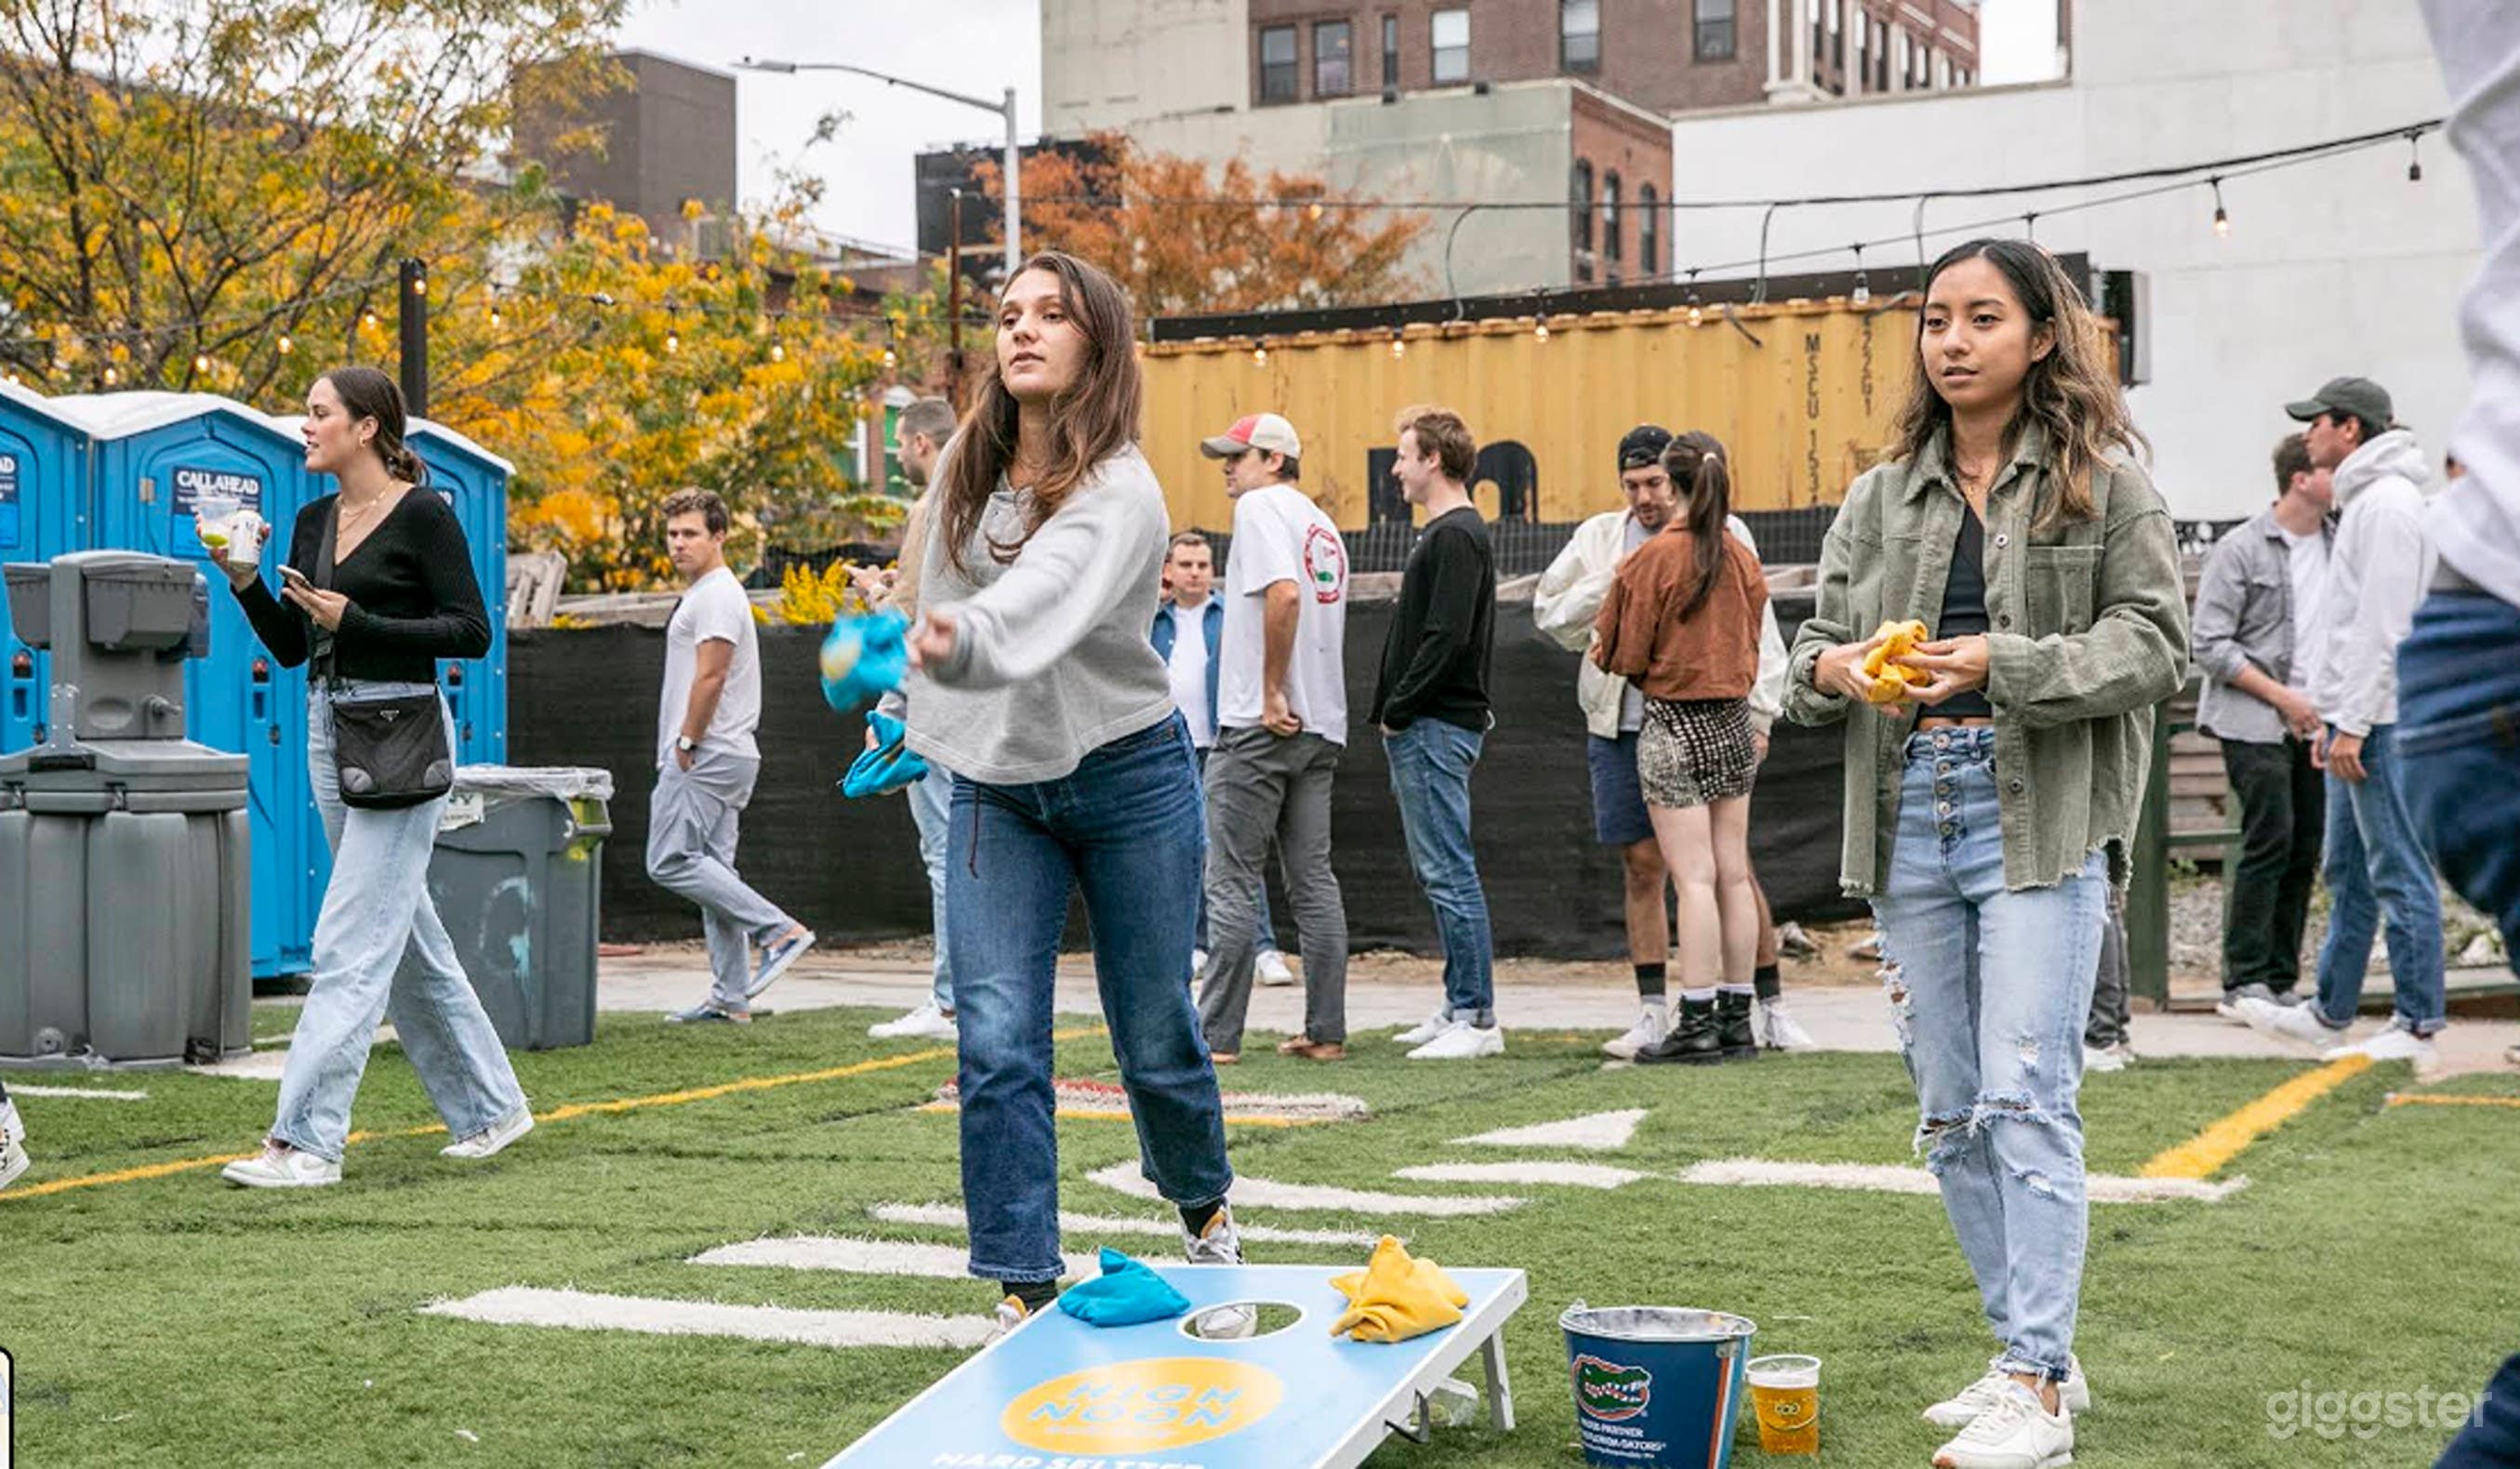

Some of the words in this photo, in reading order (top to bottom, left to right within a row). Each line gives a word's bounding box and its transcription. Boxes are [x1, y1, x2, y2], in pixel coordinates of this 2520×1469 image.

[1805, 333, 1821, 419] MSCU
[176, 470, 259, 496] CALLAHEAD
[1069, 1383, 1243, 1407] HIGH
[1027, 1400, 1234, 1427] NOON
[931, 1450, 1042, 1469] HARD
